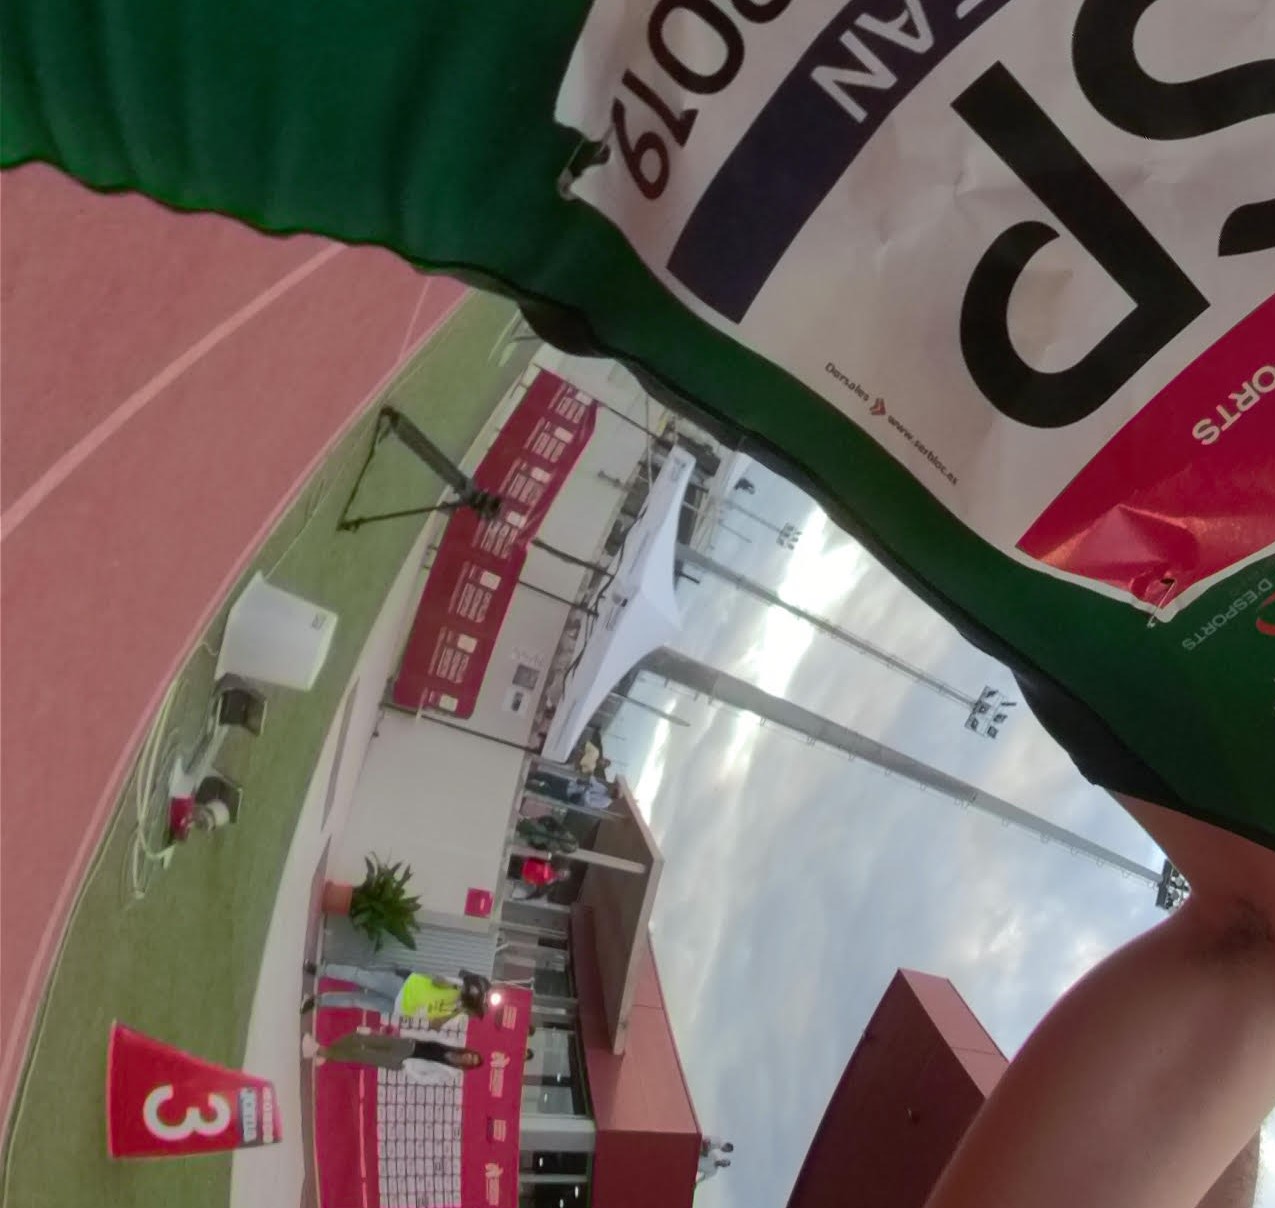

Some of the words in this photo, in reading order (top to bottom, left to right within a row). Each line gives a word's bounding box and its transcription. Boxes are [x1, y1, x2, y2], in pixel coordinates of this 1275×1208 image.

[612, 0, 791, 200] 019
[1181, 578, 1274, 651] D'ESPORTS
[143, 1084, 232, 1142] 3
